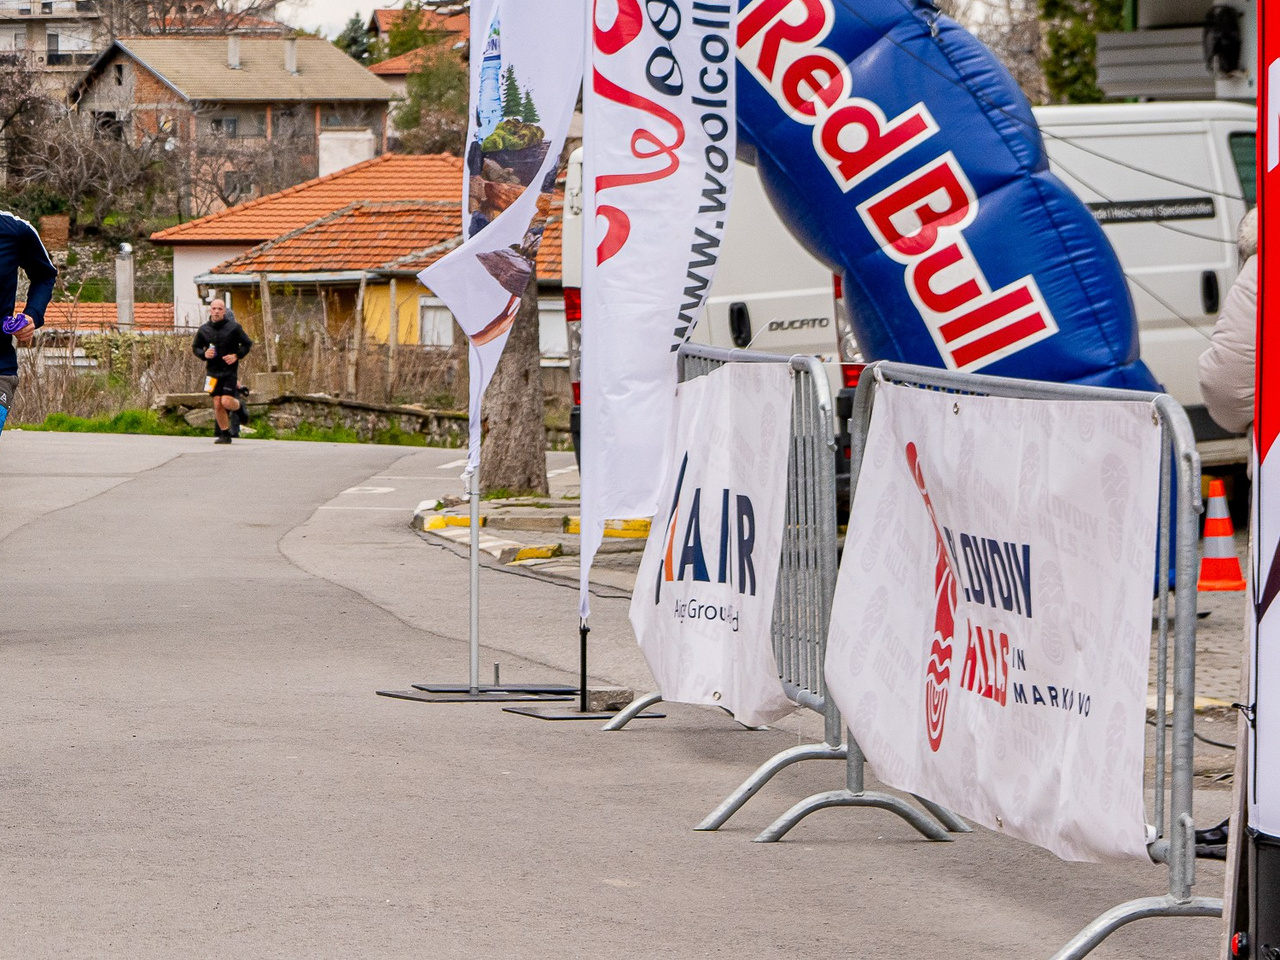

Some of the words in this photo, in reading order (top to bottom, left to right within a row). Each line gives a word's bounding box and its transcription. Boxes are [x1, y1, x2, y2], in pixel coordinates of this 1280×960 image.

[862, 157, 1052, 372] Bull
[768, 317, 829, 332] DUCATO
[1012, 647, 1026, 671] IN
